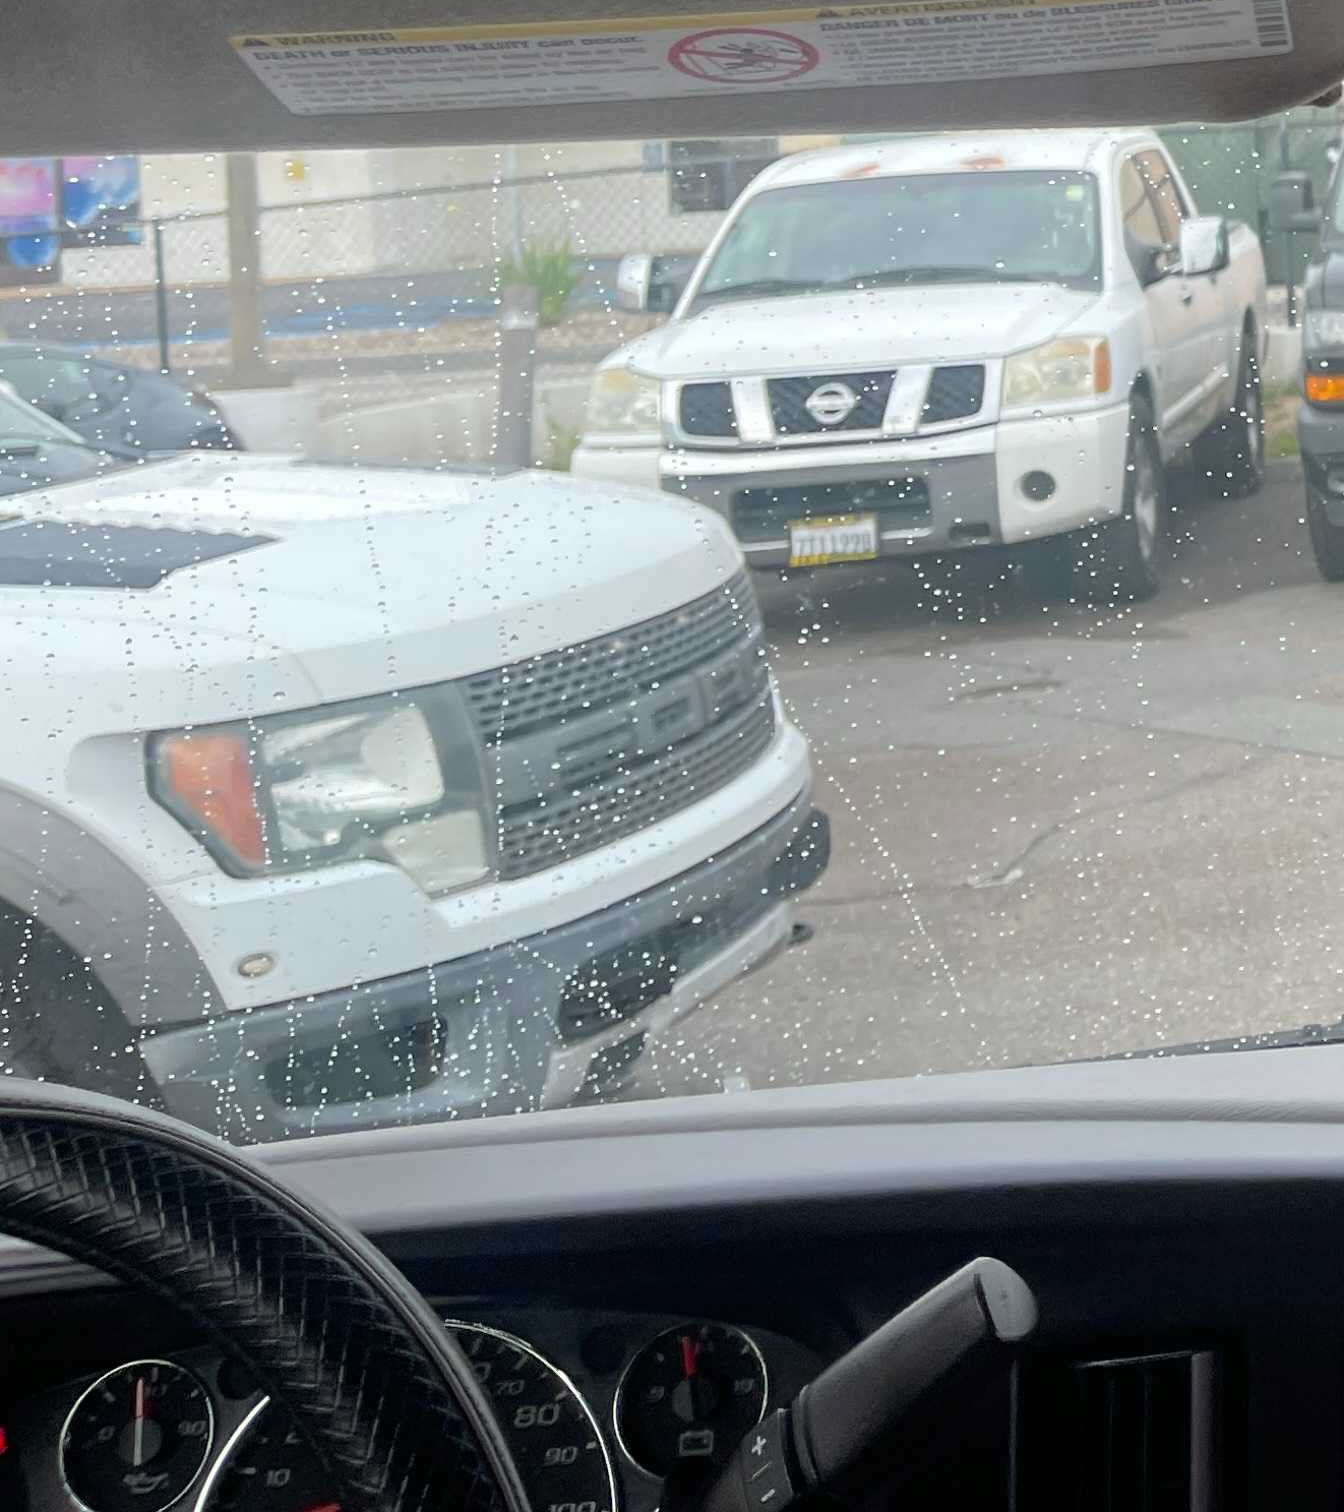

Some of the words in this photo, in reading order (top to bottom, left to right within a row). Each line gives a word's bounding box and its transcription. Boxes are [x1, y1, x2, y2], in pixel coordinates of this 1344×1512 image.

[277, 31, 396, 47] WARNING
[253, 49, 327, 62] DEATH
[356, 44, 447, 59] SERIOUS
[496, 1379, 525, 1395] 70
[513, 1403, 561, 1429] 80
[543, 1445, 578, 1466] 90
[266, 1468, 291, 1487] 10
